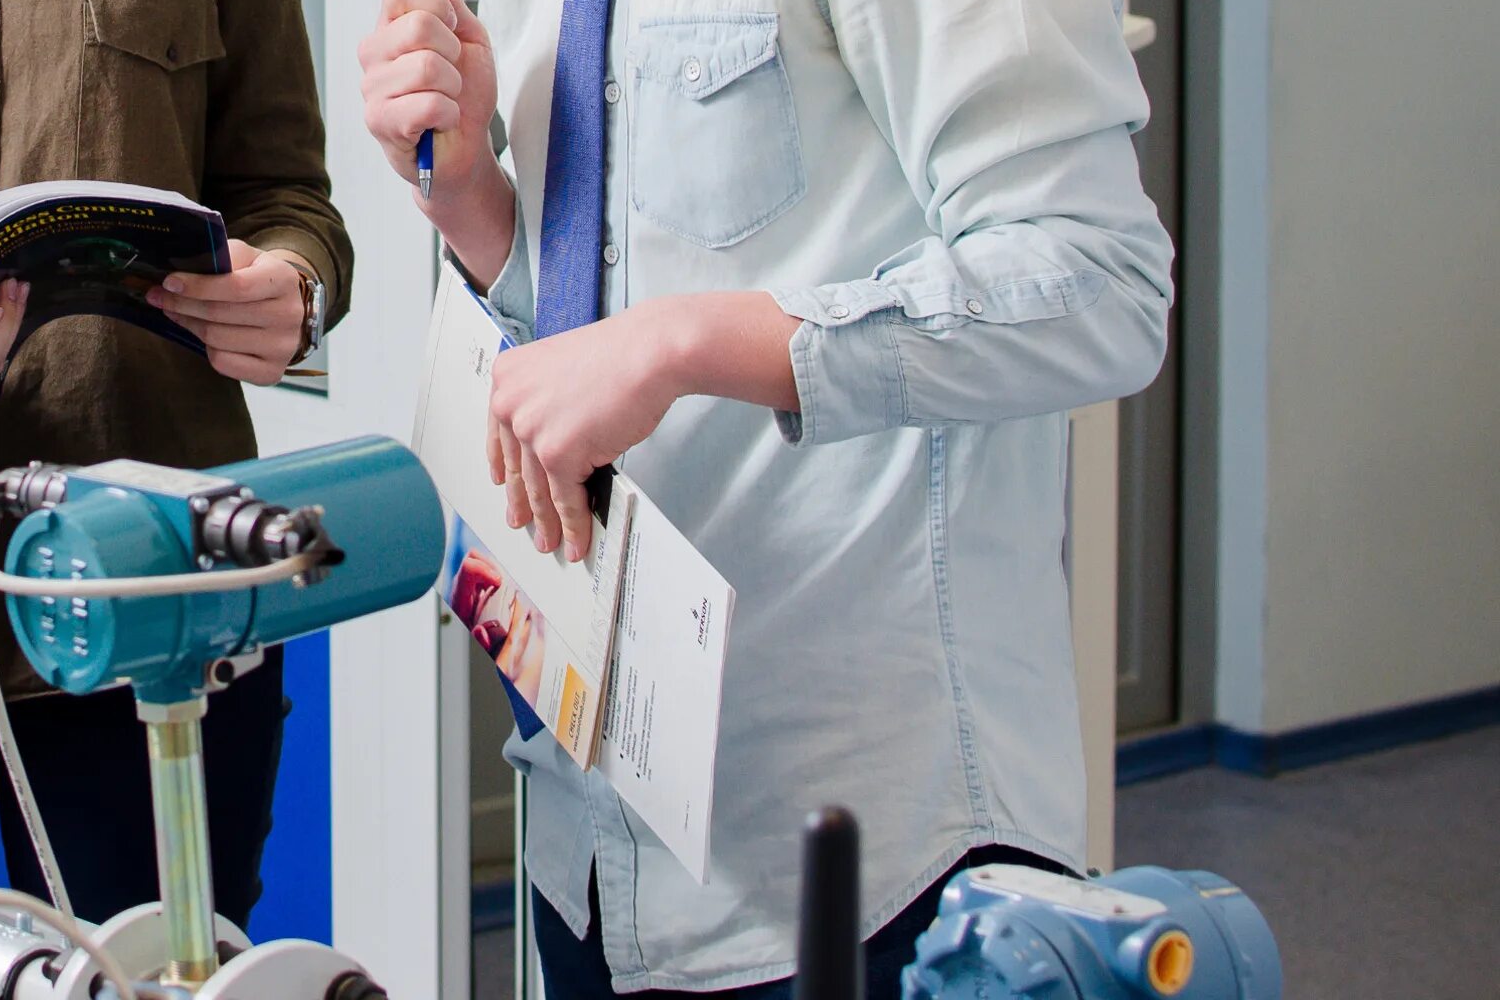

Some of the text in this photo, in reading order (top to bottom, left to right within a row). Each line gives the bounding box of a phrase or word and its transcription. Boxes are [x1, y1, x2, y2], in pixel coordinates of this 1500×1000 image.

[56, 205, 155, 217] Control
[698, 597, 708, 645] EMERSON
[568, 691, 581, 739] CHECK OUT
